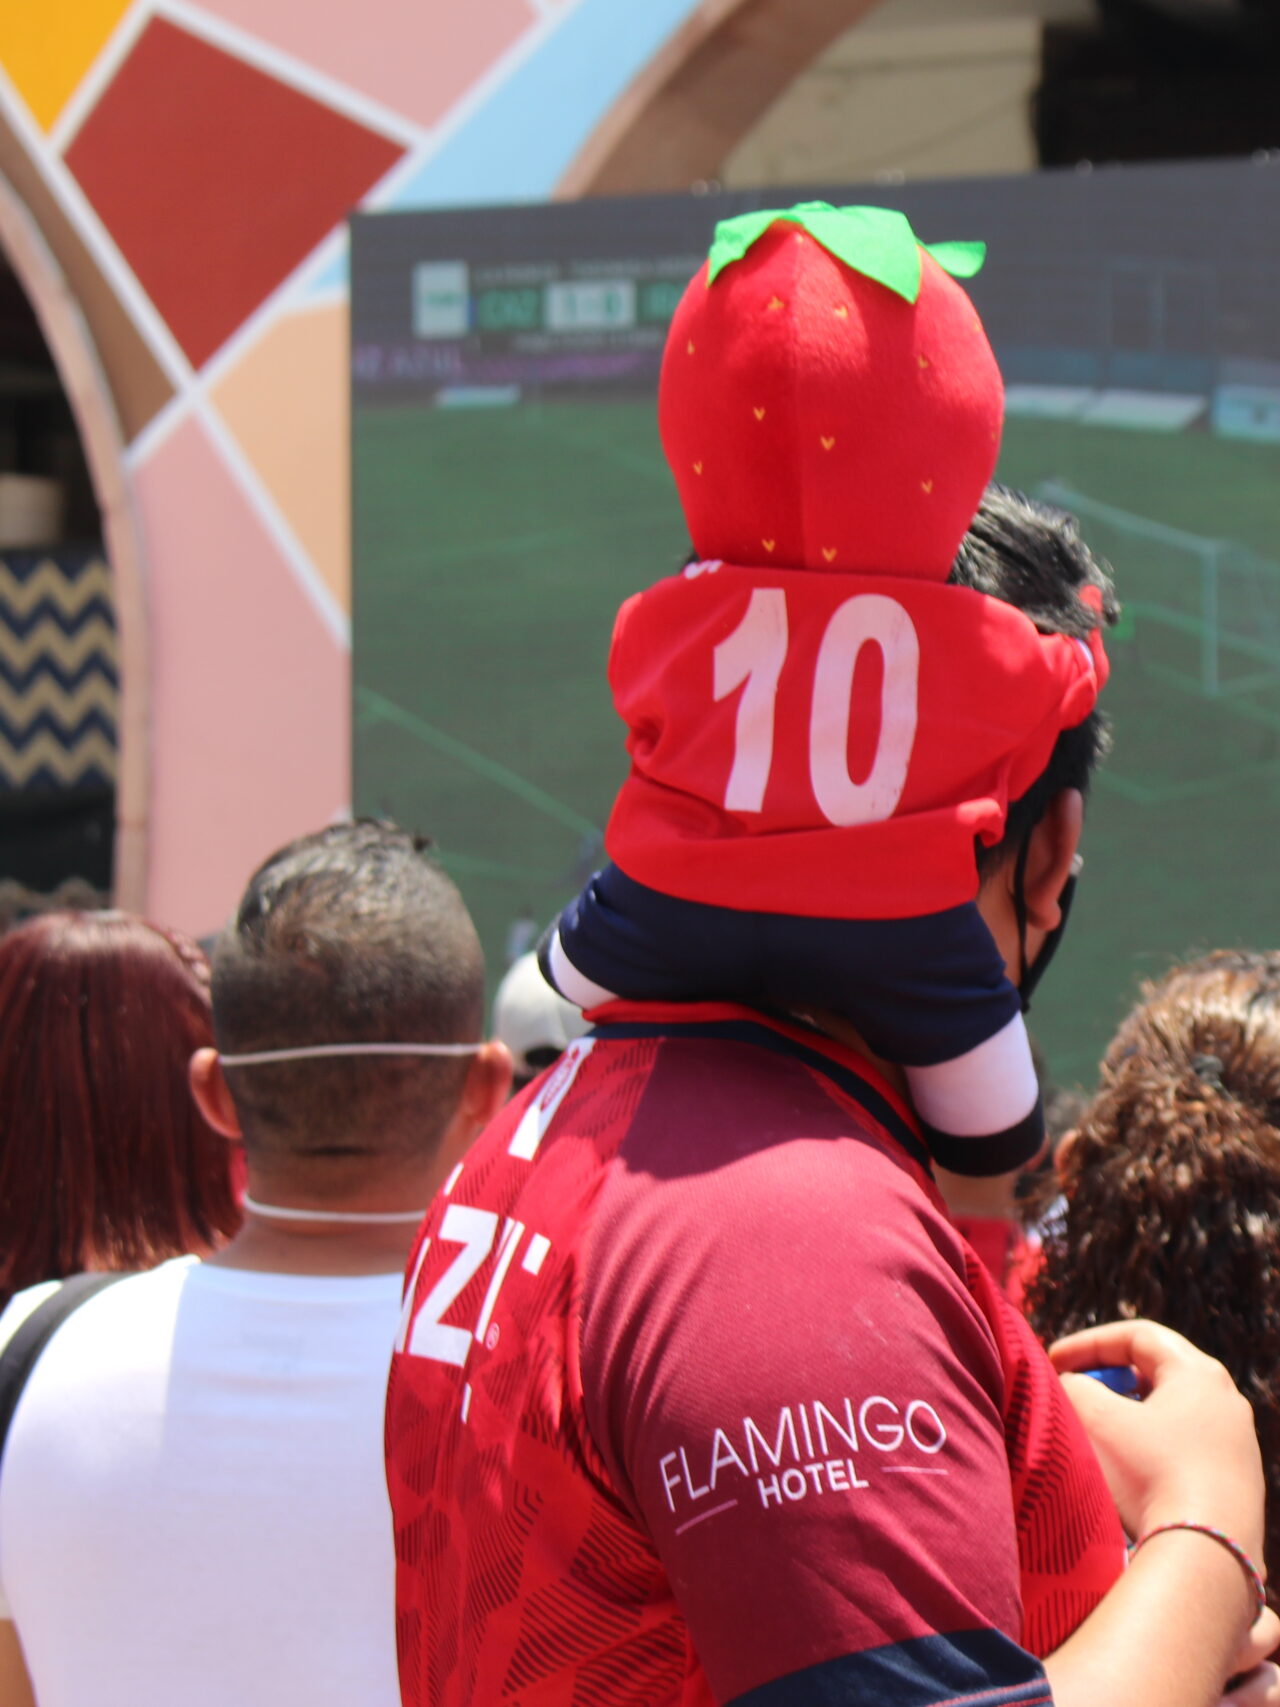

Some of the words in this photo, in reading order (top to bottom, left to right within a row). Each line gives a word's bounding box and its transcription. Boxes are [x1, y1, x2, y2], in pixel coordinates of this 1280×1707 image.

[714, 588, 919, 828] 10
[660, 1396, 947, 1512] FLAMINGO
[757, 1458, 869, 1509] HOTEL
